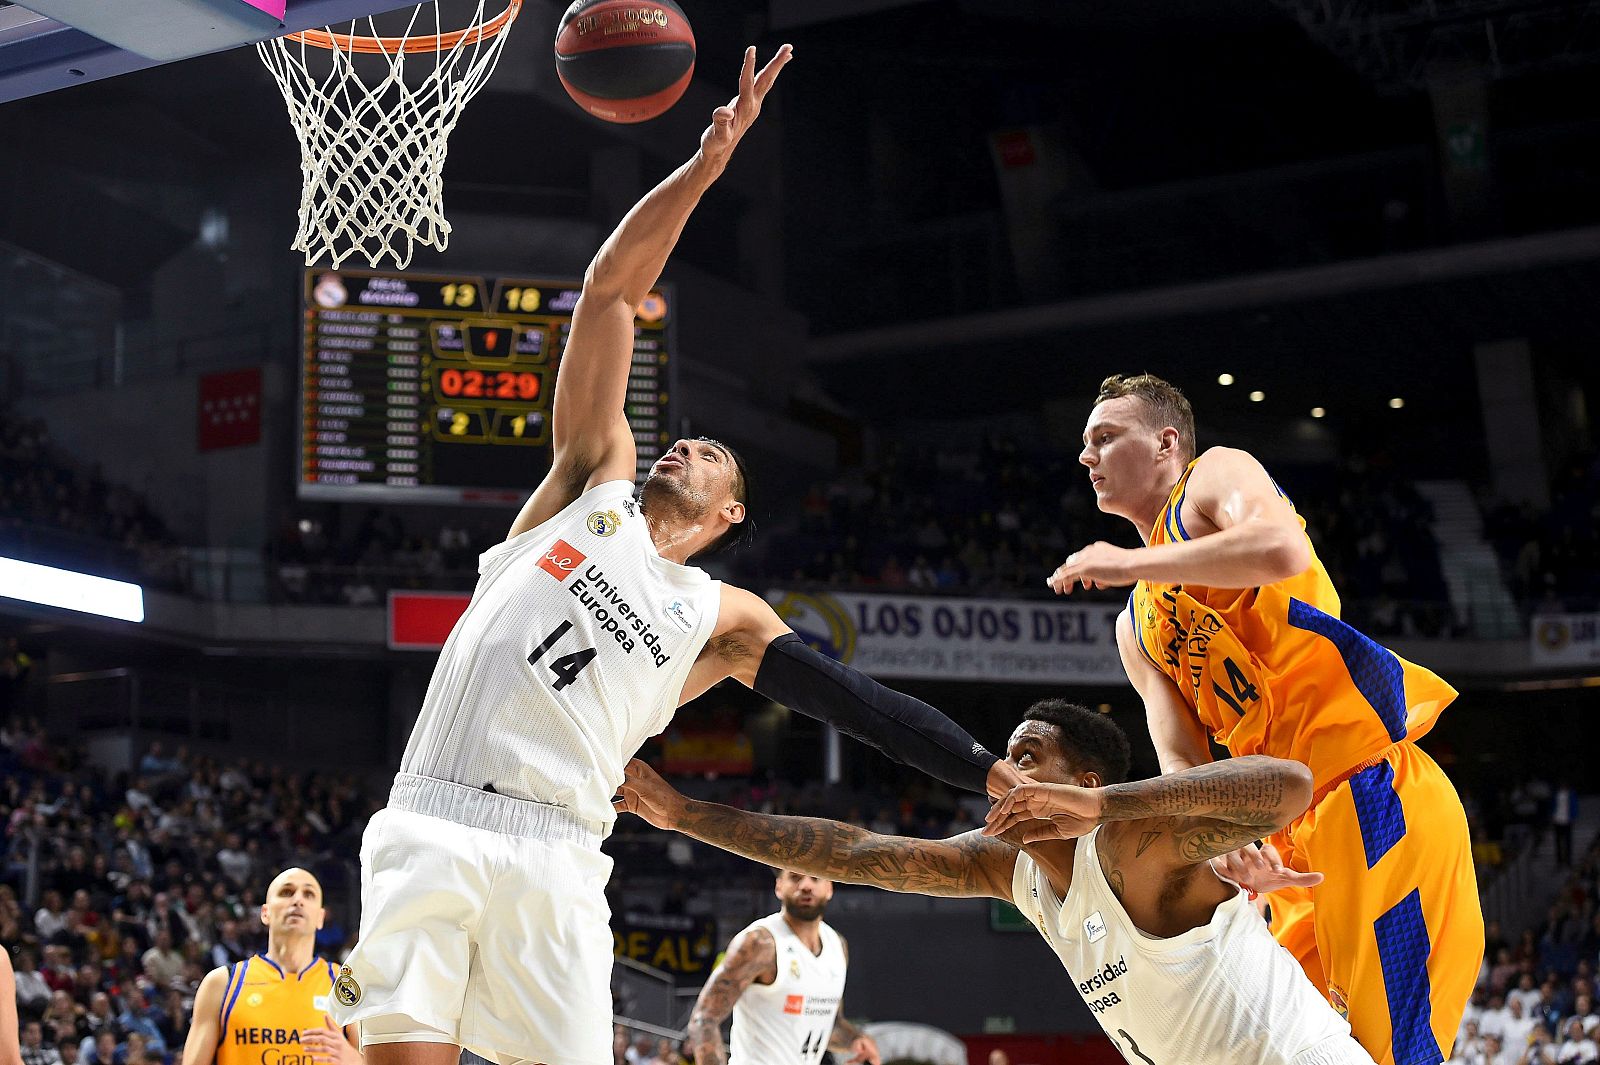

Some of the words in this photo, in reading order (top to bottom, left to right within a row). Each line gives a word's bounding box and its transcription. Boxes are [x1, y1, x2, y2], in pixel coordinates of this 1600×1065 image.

[440, 283, 476, 307] 13
[505, 287, 541, 312] 18
[441, 367, 540, 399] 02:29
[511, 415, 526, 437] 1
[568, 578, 635, 653] Europea
[585, 565, 671, 668] Universidad
[858, 602, 922, 637] LOS
[931, 605, 1021, 642] OJOS
[1031, 609, 1098, 645] DEL
[526, 619, 598, 692] 14
[1212, 656, 1260, 717] 14
[1079, 955, 1128, 995] ersidad
[1088, 991, 1122, 1015] opea
[235, 1027, 301, 1046] HERBA
